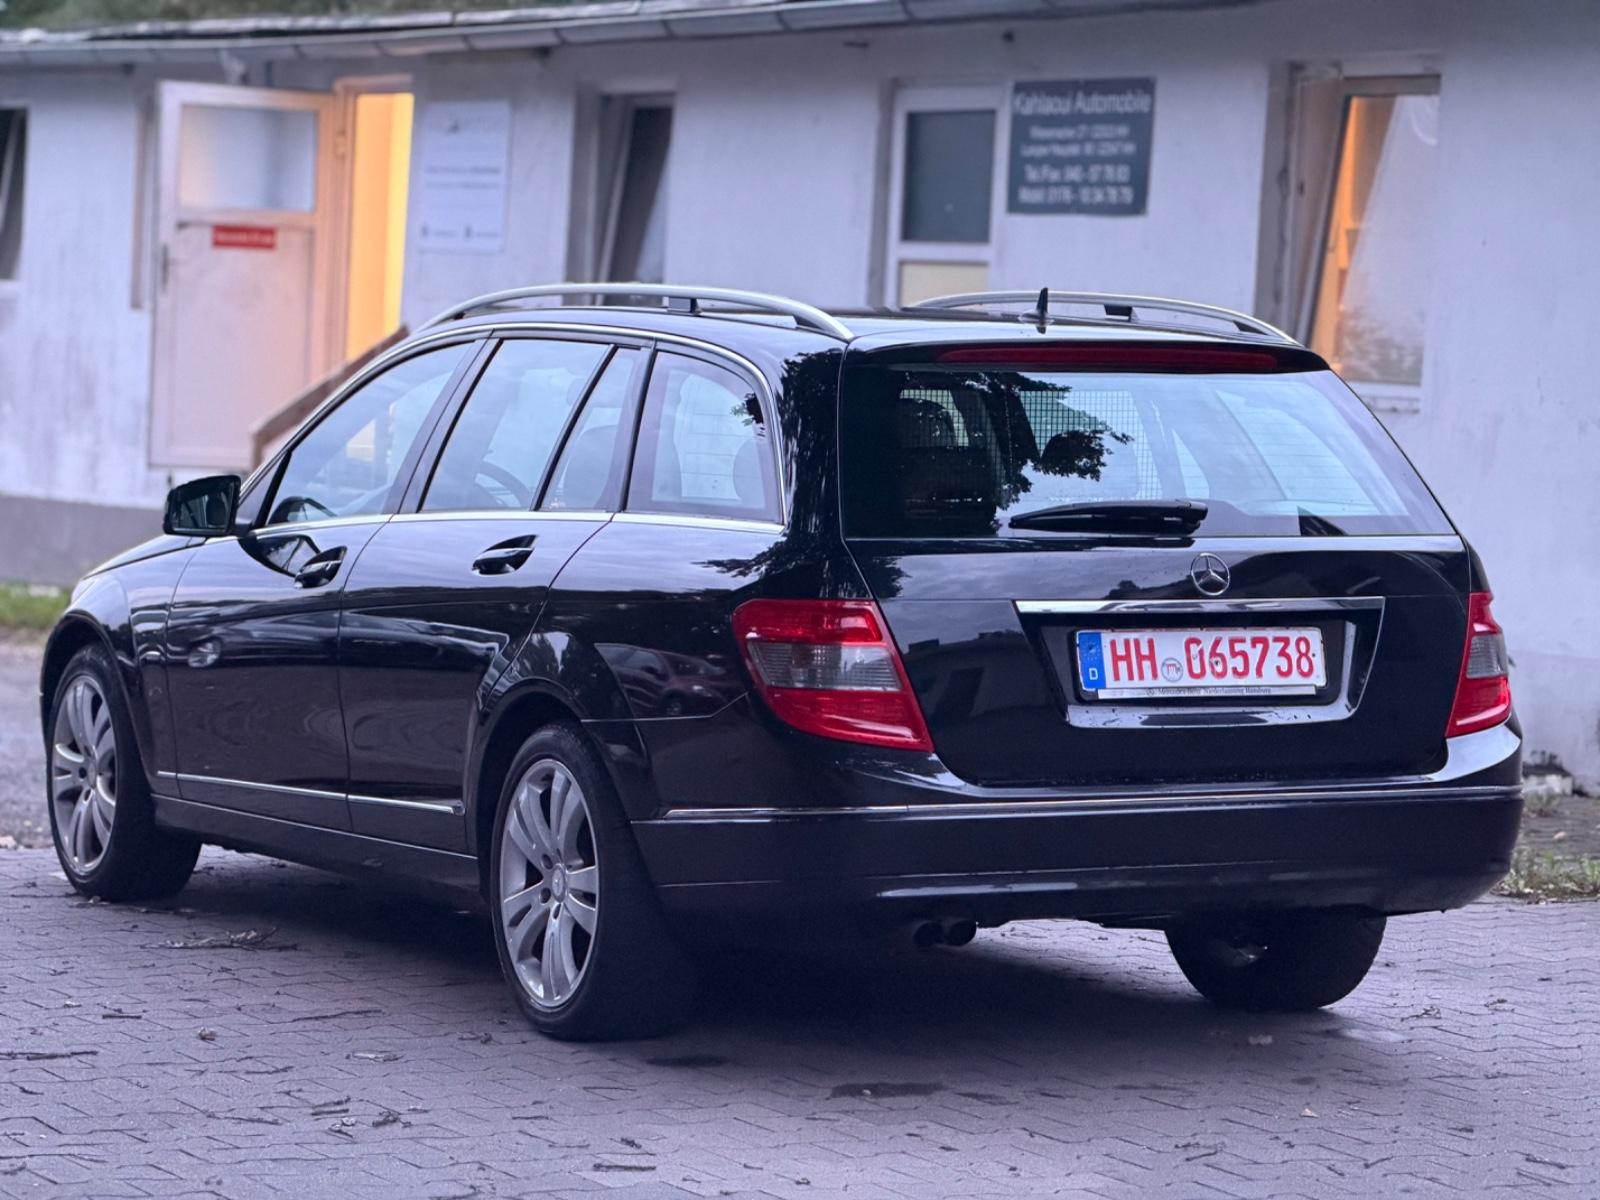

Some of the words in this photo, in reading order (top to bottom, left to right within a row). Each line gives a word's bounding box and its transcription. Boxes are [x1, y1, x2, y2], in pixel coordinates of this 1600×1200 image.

[1074, 90, 1151, 113] Automobile
[1110, 638, 1158, 682] HH
[1184, 636, 1315, 680] 065738
[1089, 668, 1098, 681] D
